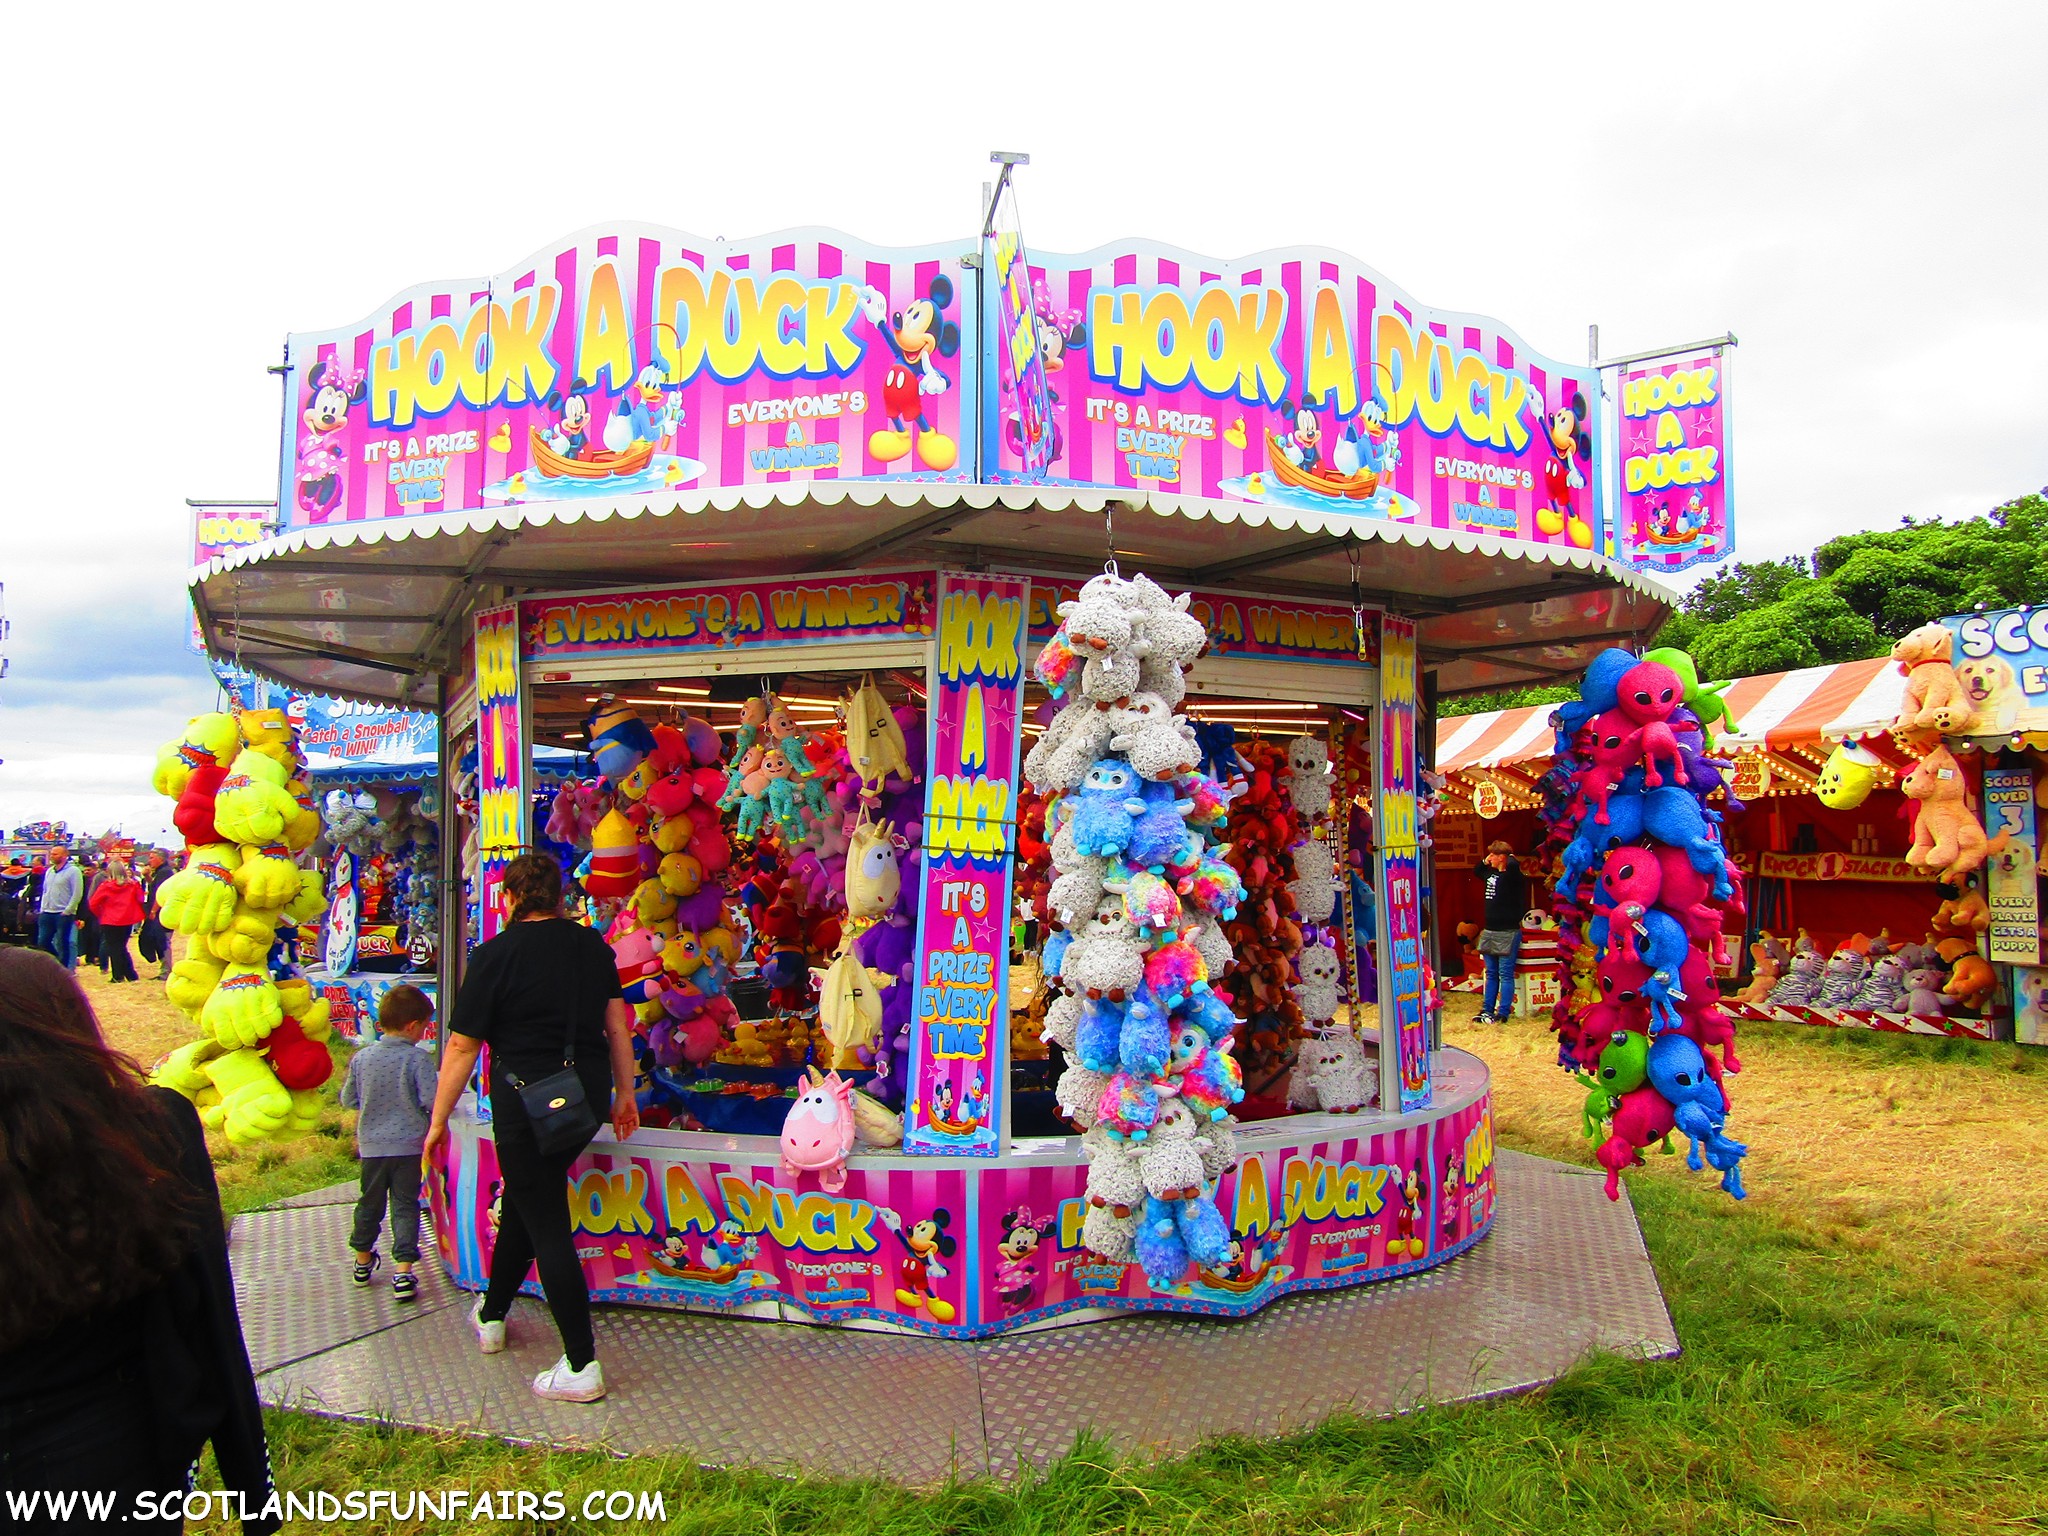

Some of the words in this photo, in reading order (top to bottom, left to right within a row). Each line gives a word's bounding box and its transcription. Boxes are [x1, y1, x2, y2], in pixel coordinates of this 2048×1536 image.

[369, 283, 560, 428] HOOK
[579, 261, 635, 392] A
[655, 266, 862, 381] DUCK
[1092, 288, 1289, 405] HOOK
[1306, 287, 1359, 416] A
[1374, 314, 1531, 452] DUCK
[1623, 365, 1718, 418] HOOK
[727, 391, 868, 427] EVERYONE'S
[1086, 397, 1131, 424] IT'S
[1135, 404, 1152, 428] A
[1157, 409, 1216, 438] PRIZE
[786, 421, 805, 443] A
[1116, 427, 1187, 458] EVERY
[1655, 411, 1684, 449] A
[363, 439, 400, 464] IT'S
[405, 438, 421, 457] A
[425, 430, 480, 454] PRIZE
[749, 445, 841, 472] WINNER
[388, 455, 450, 484] EVERY
[1127, 453, 1180, 482] TIME
[1434, 456, 1534, 490] EVERYONE'S
[1625, 445, 1719, 494] DUCK
[396, 480, 443, 505] TIME
[1477, 484, 1492, 504] A
[1453, 502, 1520, 531] WINNER
[198, 517, 264, 546] HOOK
[544, 593, 734, 647] EVERYONE'S
[737, 591, 764, 635] A
[770, 583, 905, 634] WINNER
[1219, 602, 1245, 644] A
[1248, 606, 1359, 653] WINNER
[939, 592, 1022, 683] HOOK
[476, 622, 518, 707] HOOK
[1382, 631, 1416, 708] HOOK
[302, 723, 339, 745] Catch
[341, 727, 351, 741] a
[354, 716, 410, 740] Snowball
[960, 684, 986, 770] A
[329, 743, 342, 758] to
[345, 738, 379, 757] WIN!!
[493, 703, 506, 781] A
[1730, 773, 1761, 785] £10
[1734, 762, 1760, 773] WIN
[1985, 774, 2031, 788] SCORE
[1988, 790, 2029, 803] OVER
[482, 786, 520, 863] DUCK
[928, 776, 1010, 861] DUCK
[1383, 789, 1417, 861] DUCK
[2001, 805, 2025, 836] 3
[1764, 854, 1816, 877] KNOCK
[1821, 852, 1837, 877] 1
[1844, 858, 1889, 876] STACK
[941, 880, 987, 914] IT'S
[1392, 878, 1412, 905] IT'S
[1990, 896, 2034, 909] EVERY
[1990, 911, 2037, 923] PLAYER
[356, 935, 391, 953] UCK
[952, 916, 971, 948] A
[1991, 926, 2024, 938] GETS
[2026, 927, 2038, 938] A
[1992, 940, 2037, 953] PUPPY
[928, 951, 991, 984] PRIZE
[919, 985, 996, 1021] EVERY
[928, 1021, 985, 1056] TIME
[664, 1164, 717, 1235] A
[720, 1176, 879, 1251] DUCK
[1234, 1156, 1271, 1238] A
[1283, 1159, 1391, 1226] DUCK
[1309, 1224, 1382, 1246] EVERYONE'S
[1341, 1242, 1350, 1254] A
[785, 1258, 883, 1277] EVERYONE'S
[1053, 1253, 1083, 1274] IT'S
[1072, 1263, 1128, 1279] EVERY
[1320, 1252, 1368, 1272] WINNER
[804, 1288, 870, 1304] WINNER
[825, 1276, 840, 1289] A
[1079, 1276, 1120, 1291] TIME
